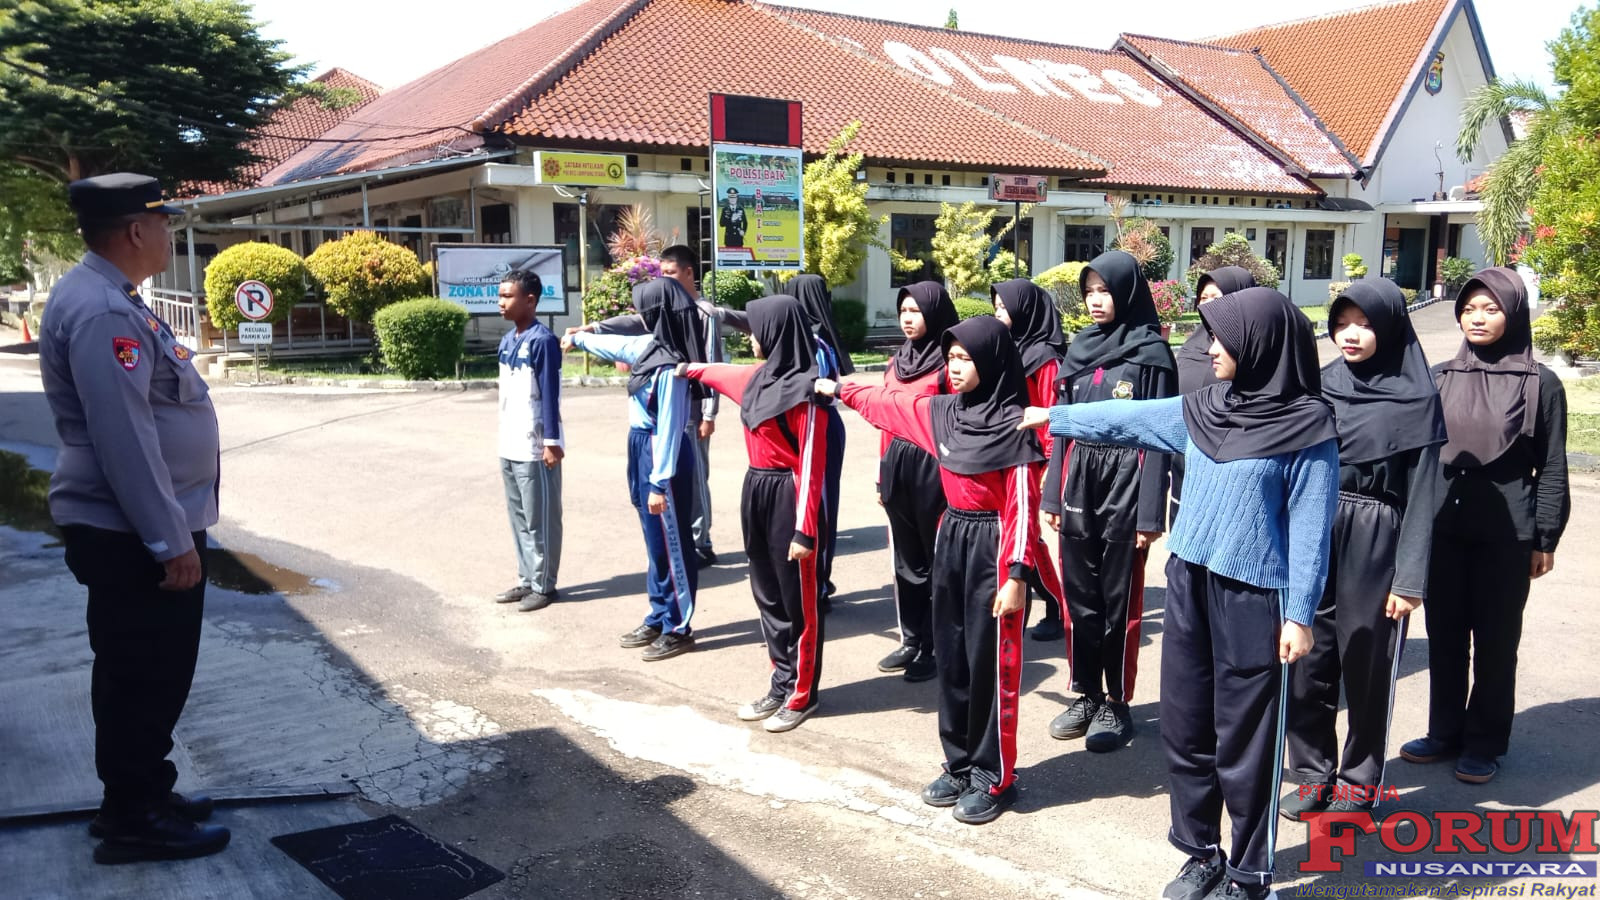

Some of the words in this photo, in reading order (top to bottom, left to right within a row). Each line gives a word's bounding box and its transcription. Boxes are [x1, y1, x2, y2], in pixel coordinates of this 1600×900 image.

[730, 168, 761, 179] POLISI
[764, 170, 785, 180] BAIK
[448, 285, 484, 297] ZONA
